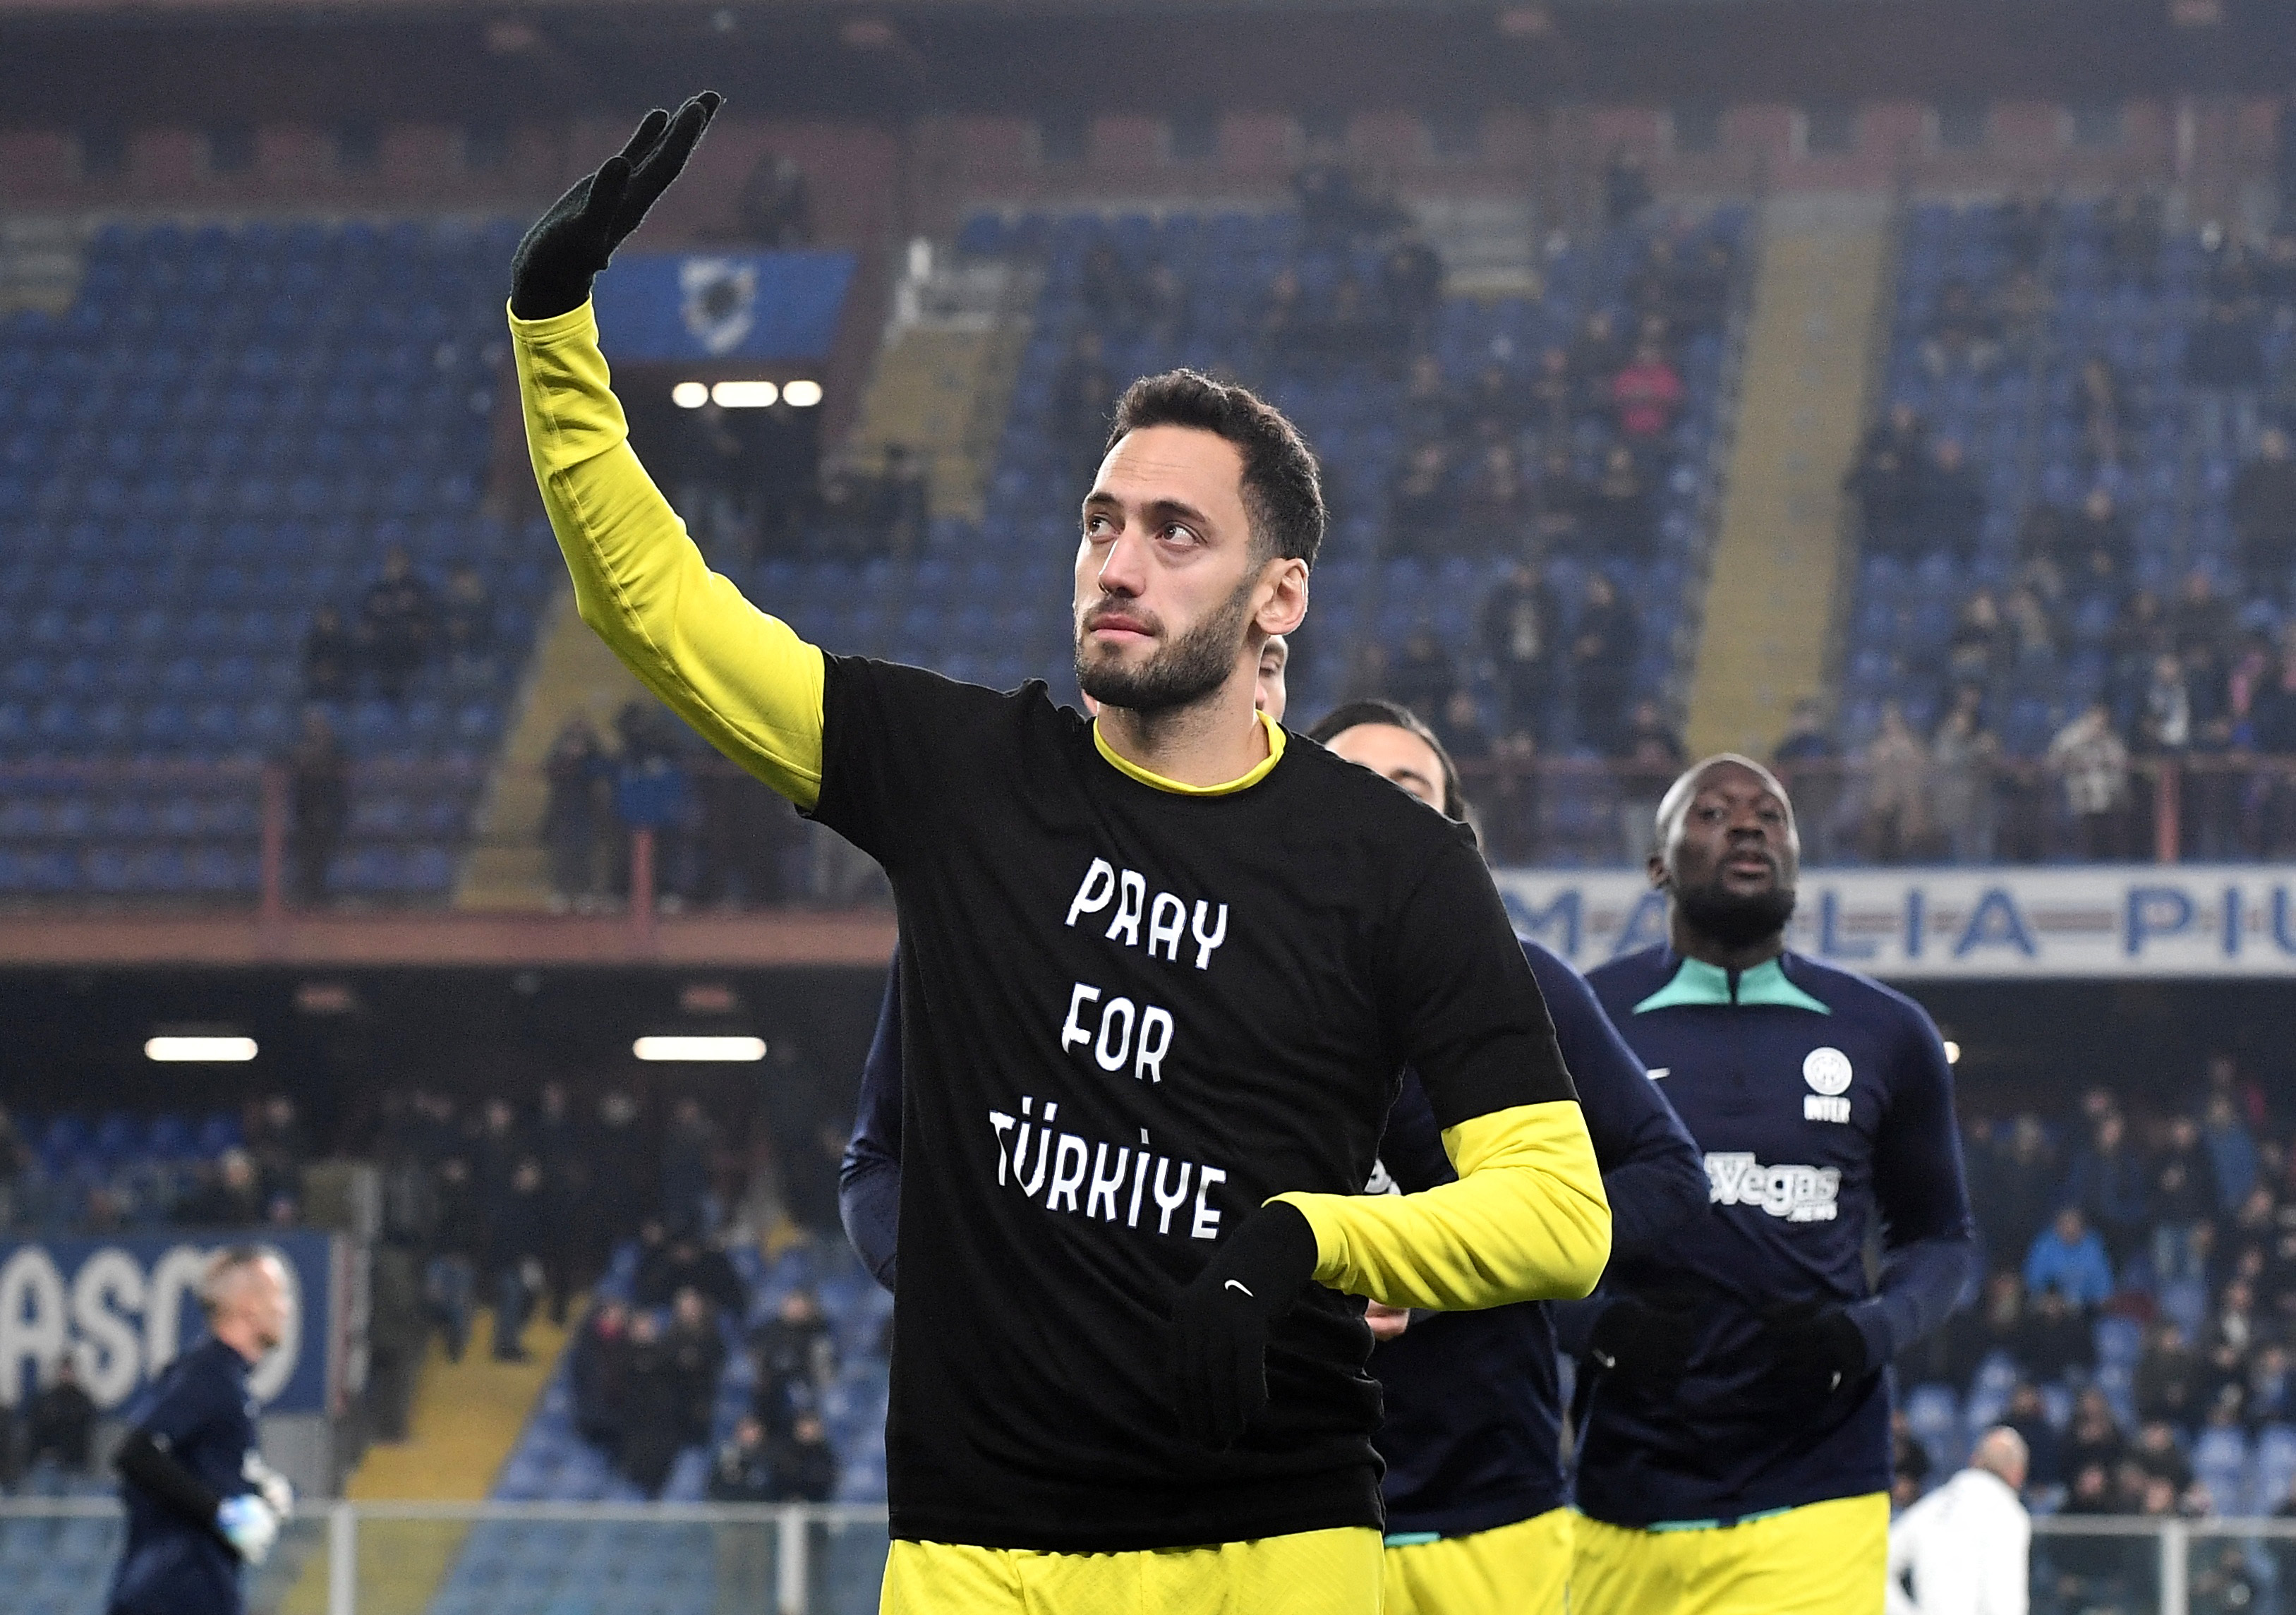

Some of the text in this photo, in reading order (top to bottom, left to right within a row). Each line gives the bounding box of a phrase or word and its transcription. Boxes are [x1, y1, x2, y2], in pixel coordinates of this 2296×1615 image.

[1064, 857, 1228, 970] PRAY
[1505, 886, 2038, 958] MALIA
[1061, 981, 1175, 1083] FOR
[989, 1095, 1227, 1240] TÜRKİYE
[1703, 1151, 1842, 1217] Vegas
